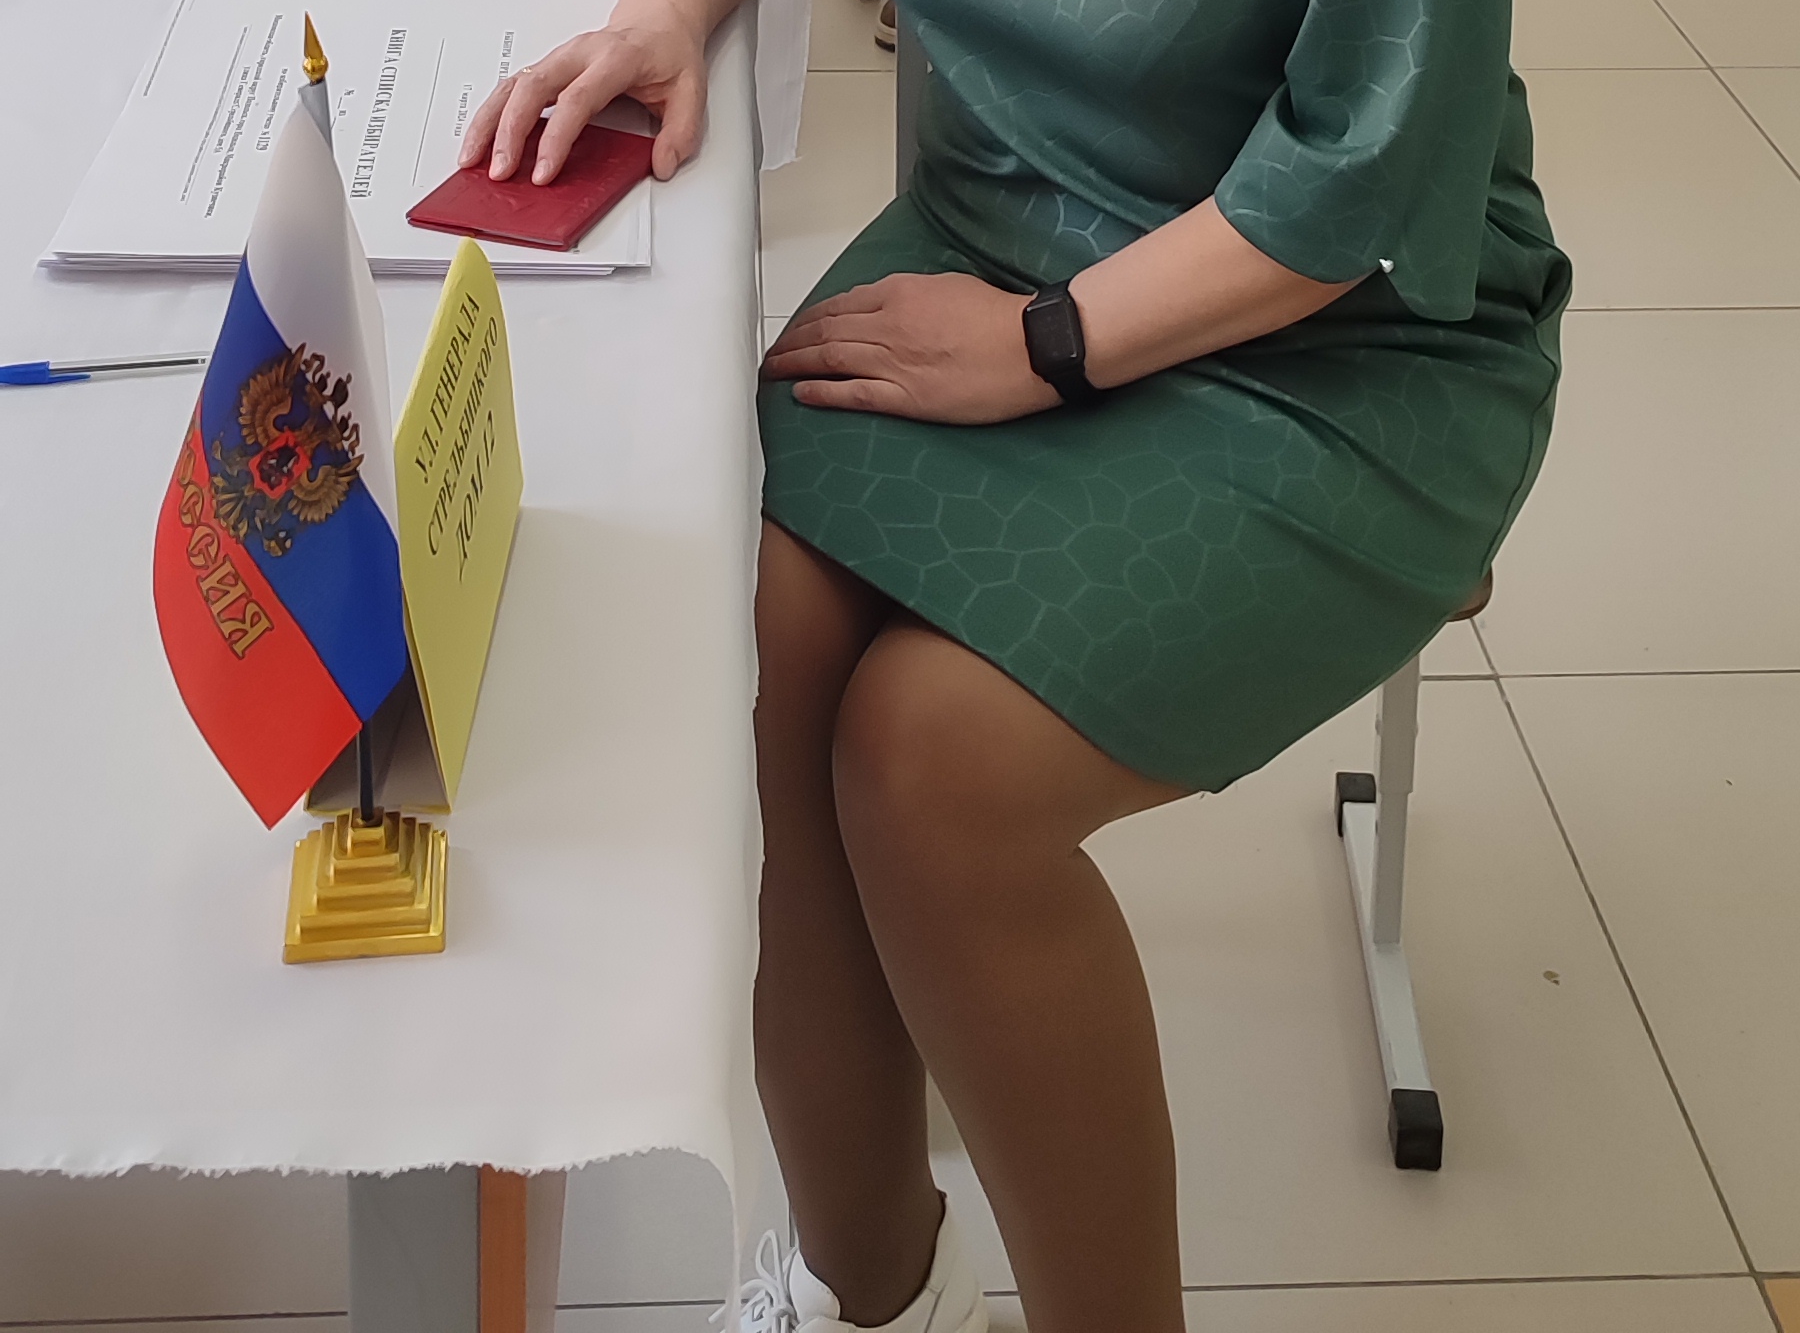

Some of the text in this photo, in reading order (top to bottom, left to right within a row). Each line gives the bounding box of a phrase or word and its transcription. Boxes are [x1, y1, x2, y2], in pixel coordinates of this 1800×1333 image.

[350, 29, 407, 198] КНИГА СПИСКА ИЗБИРАТЕЛЕЙ
[427, 316, 498, 556] СТРЕЛЬБИЦКОГО
[429, 291, 480, 431] ГЕНЕРАЛА
[176, 428, 275, 661] ОССИЯ
[456, 410, 496, 583] ДОМ 12
